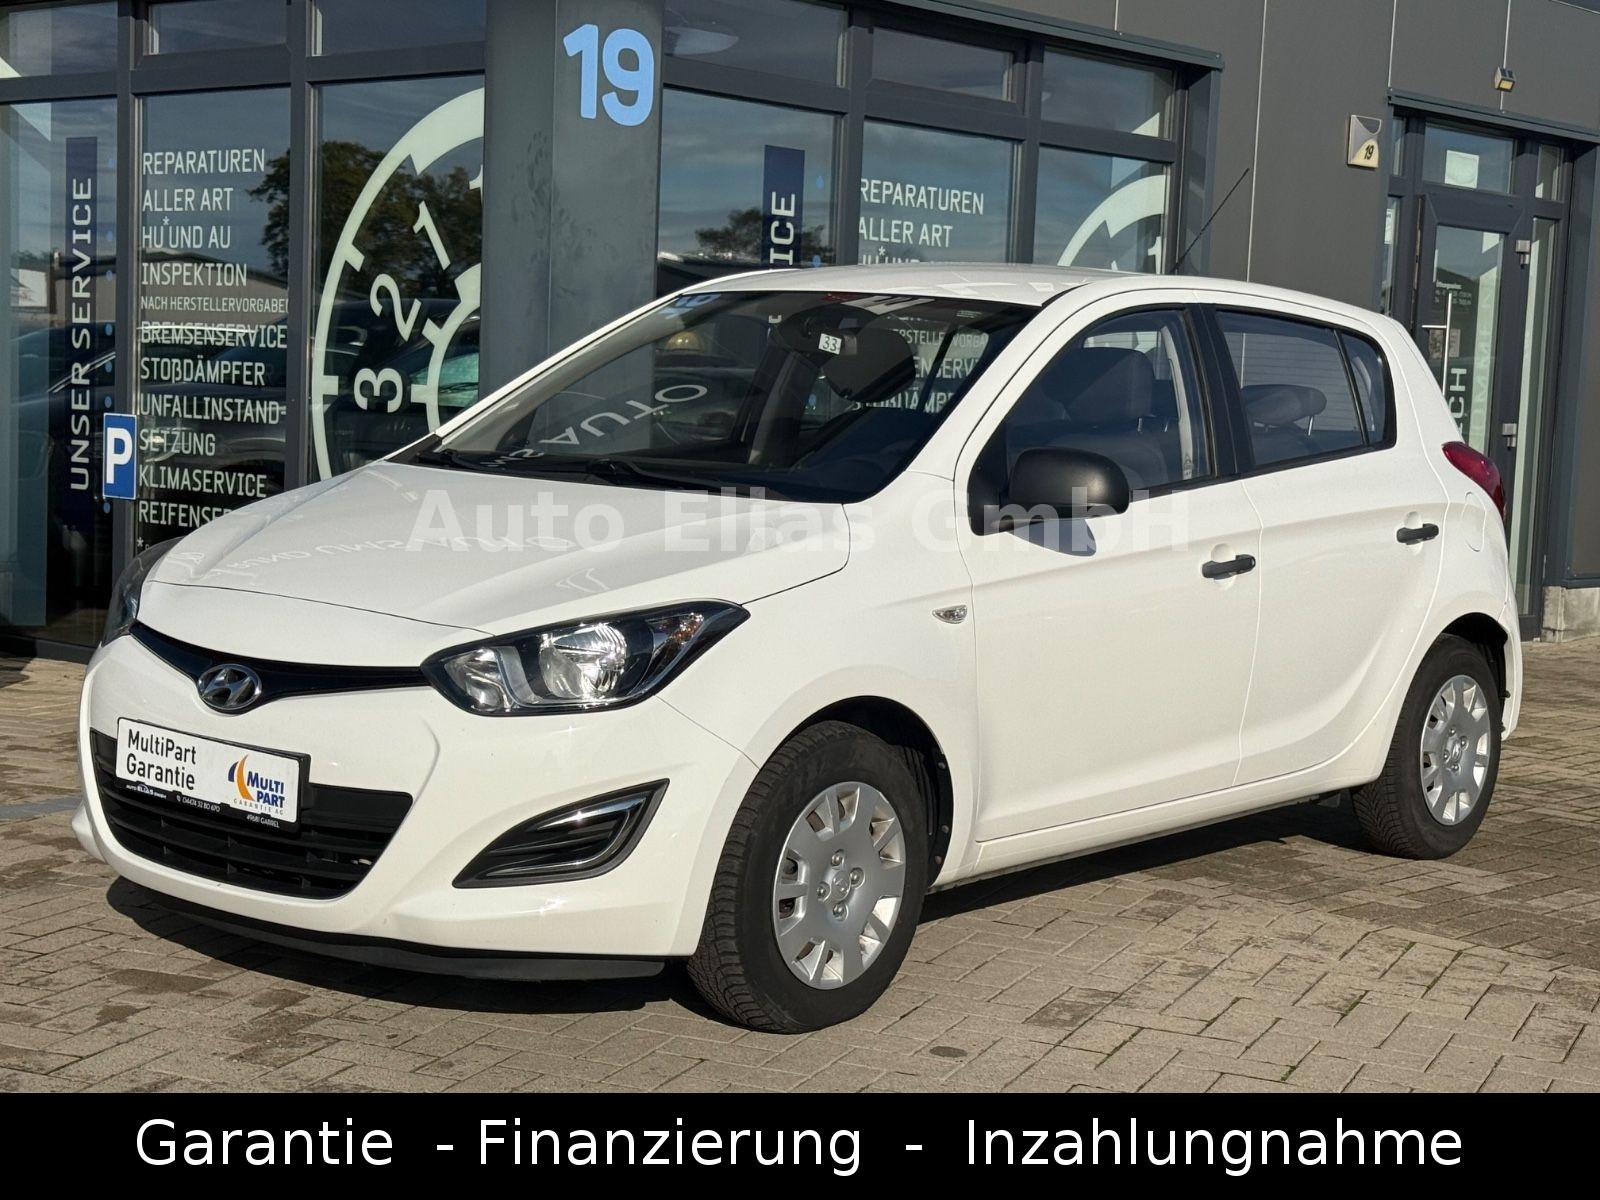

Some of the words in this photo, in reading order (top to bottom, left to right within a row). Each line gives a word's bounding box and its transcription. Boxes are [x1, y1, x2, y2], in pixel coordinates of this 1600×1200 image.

[563, 24, 655, 126] 19
[142, 149, 265, 175] REPARATUREN
[1363, 144, 1374, 160] 19
[142, 189, 195, 212] ALLER
[200, 187, 234, 211] ART
[861, 179, 984, 215] REPARATUREN
[169, 225, 203, 248] UND
[208, 225, 231, 248] AU
[770, 191, 796, 266] ICE
[859, 216, 913, 244] ALLER
[919, 223, 953, 248] ART
[72, 178, 92, 350] SERVICE
[141, 262, 247, 287] INSPEKTION
[141, 296, 168, 310] NACH
[141, 321, 288, 348] BREMSENSERVICE
[354, 368, 403, 413] 3
[140, 393, 286, 424] UNFALLINSTAND-
[71, 362, 90, 491] UNSER
[106, 427, 133, 484] P
[139, 428, 216, 457] SETZUNG
[138, 466, 267, 498] KLIMASERVICE
[139, 500, 232, 528] REIFENS
[128, 729, 196, 765] MultiPart
[126, 754, 195, 791] Garantie
[247, 770, 284, 794] MULTI
[256, 790, 285, 809] PART
